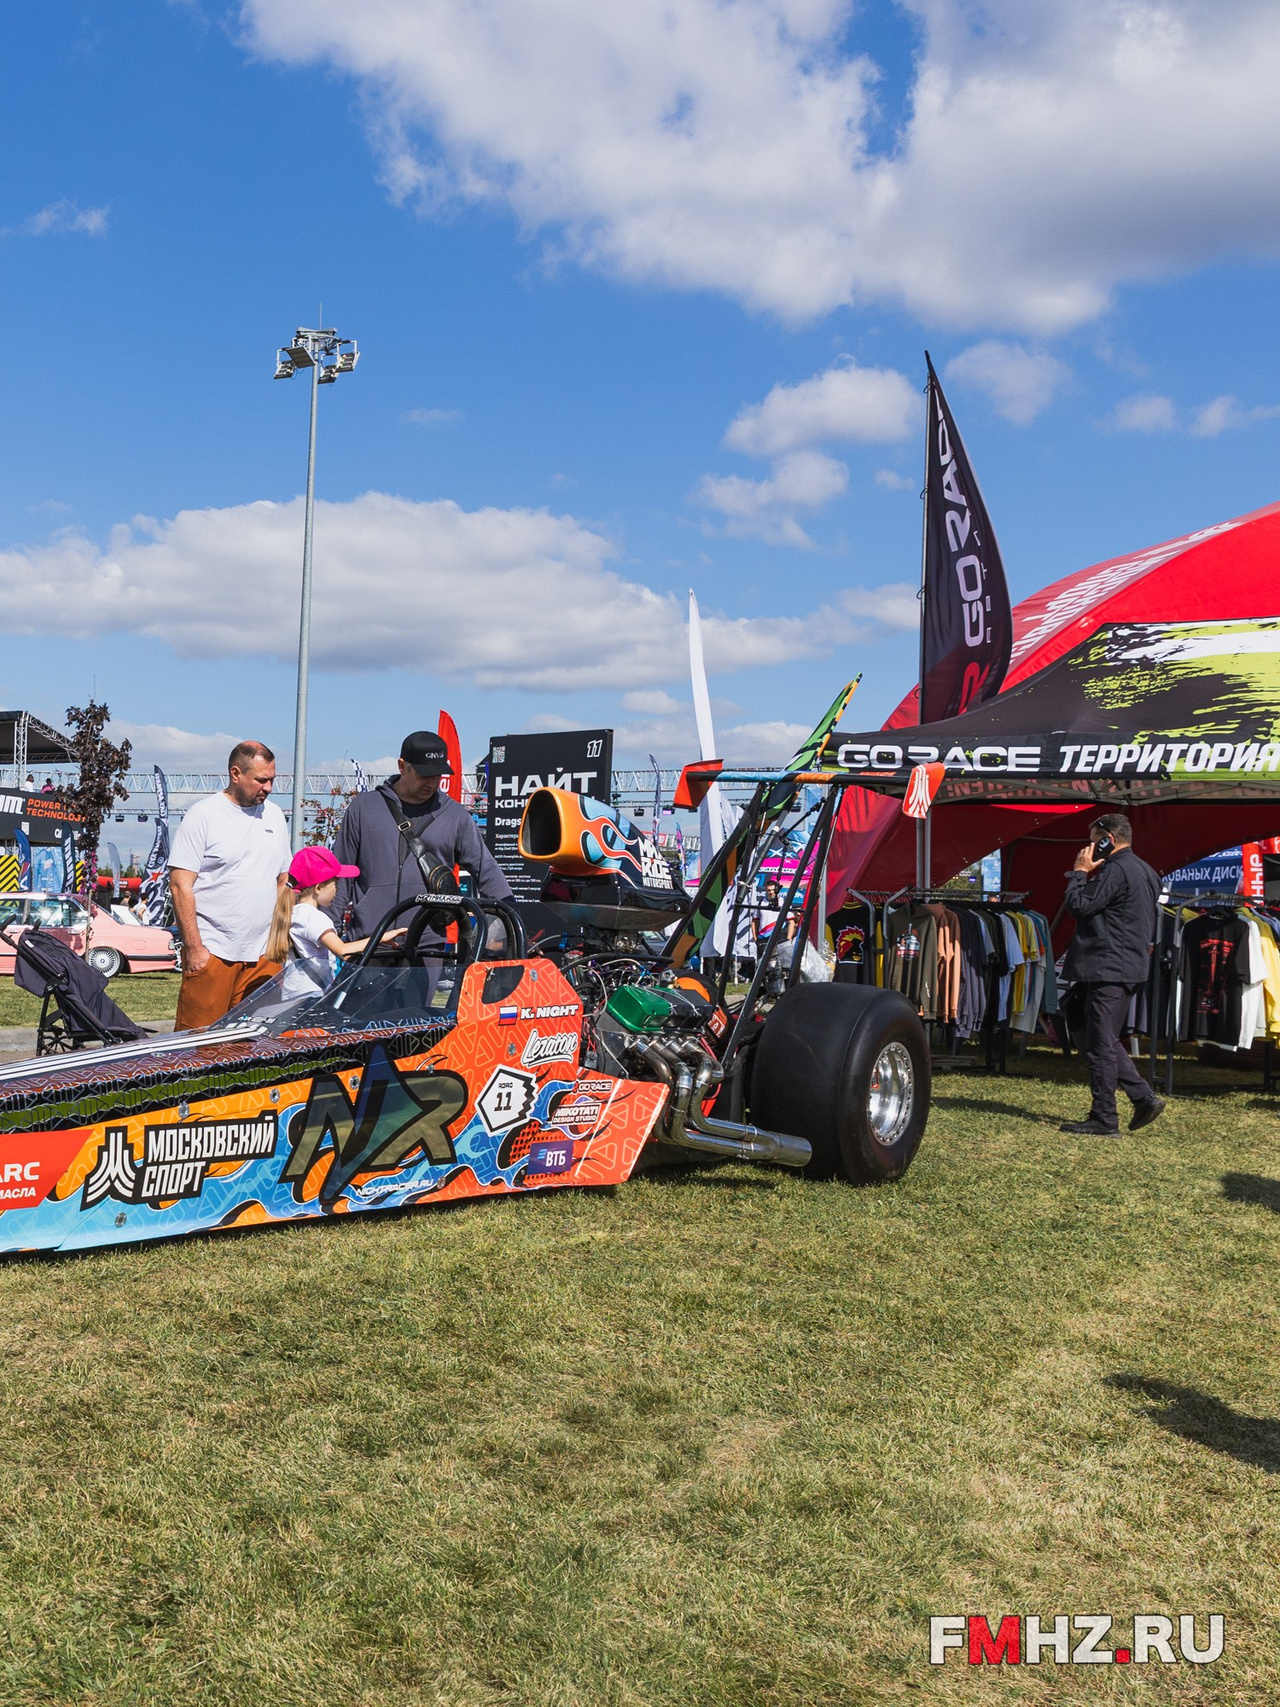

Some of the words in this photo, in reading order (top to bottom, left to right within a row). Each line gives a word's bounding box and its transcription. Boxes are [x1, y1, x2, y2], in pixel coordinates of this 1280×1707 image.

[586, 739, 603, 758] 11
[1059, 742, 1280, 774] ТЕРРИТОРИЯ
[494, 767, 598, 797] НАЙТ
[27, 798, 61, 810] POWER
[494, 817, 522, 829] Drags
[1212, 865, 1244, 882] ДИСК
[642, 877, 674, 890] MOTORSPORT
[536, 1004, 579, 1018] NIGHT
[493, 1091, 513, 1112] 11
[554, 1115, 574, 1125] DESIGN
[574, 1114, 597, 1124] STUDIO
[555, 1105, 599, 1118] MIKOTATI
[148, 1115, 276, 1162] МОСКОВСКИЙ
[545, 1150, 567, 1168] ВТБ
[141, 1162, 206, 1198] СПОРТ
